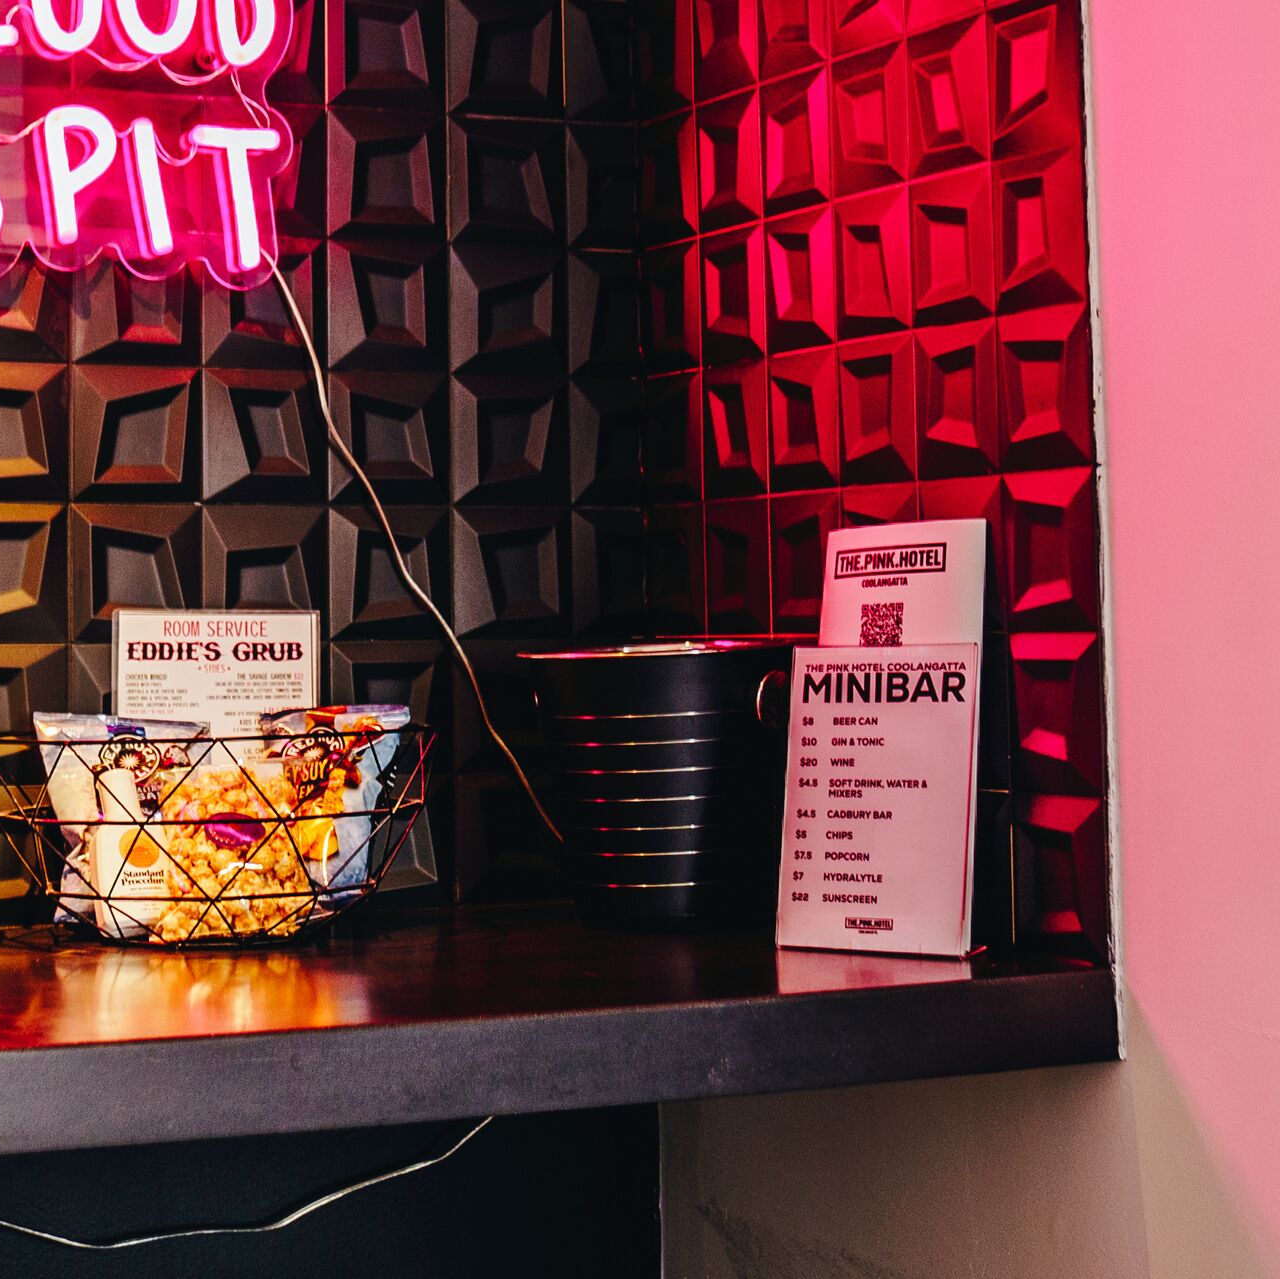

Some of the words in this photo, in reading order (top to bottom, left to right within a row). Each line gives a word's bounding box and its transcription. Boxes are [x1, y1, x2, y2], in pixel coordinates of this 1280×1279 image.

[839, 549, 941, 573] THE.PINK.HOTEL
[861, 577, 908, 588] COOLANGATTA
[163, 621, 200, 637] ROOM
[207, 621, 267, 637] SERVICE
[127, 641, 222, 662] EDDIE'S
[232, 642, 303, 662] GRUB
[204, 665, 225, 673] SIDES
[805, 664, 825, 673] THE
[826, 664, 849, 672] PINK
[851, 663, 885, 672] HOTEL
[887, 662, 966, 671] COOLANGATTA
[802, 671, 967, 704] MINIBAR
[802, 717, 814, 726] $8
[833, 717, 856, 725] BEER
[858, 717, 878, 725] CAN
[801, 737, 817, 747] $10
[831, 737, 847, 746] GIN
[849, 738, 855, 746] &
[857, 738, 884, 746] TONIC
[800, 757, 818, 767] $20
[830, 758, 855, 767] WINE
[798, 777, 818, 788] $4.5
[829, 779, 852, 788] SOFT
[854, 779, 884, 789] DRINK,
[886, 779, 919, 788] WATER
[921, 780, 927, 788] &
[828, 790, 863, 798] MIXERS
[796, 808, 816, 819] $4.5
[826, 810, 871, 819] CADBURY
[873, 811, 892, 819] BAR
[795, 829, 807, 840] $5
[825, 831, 853, 840] CHIPS
[794, 850, 812, 860] $7.5
[824, 852, 870, 861] POPCORN
[123, 870, 165, 878] Standard
[792, 871, 804, 881] $7
[791, 892, 809, 902] $22
[822, 894, 878, 904] SUNSCREEN
